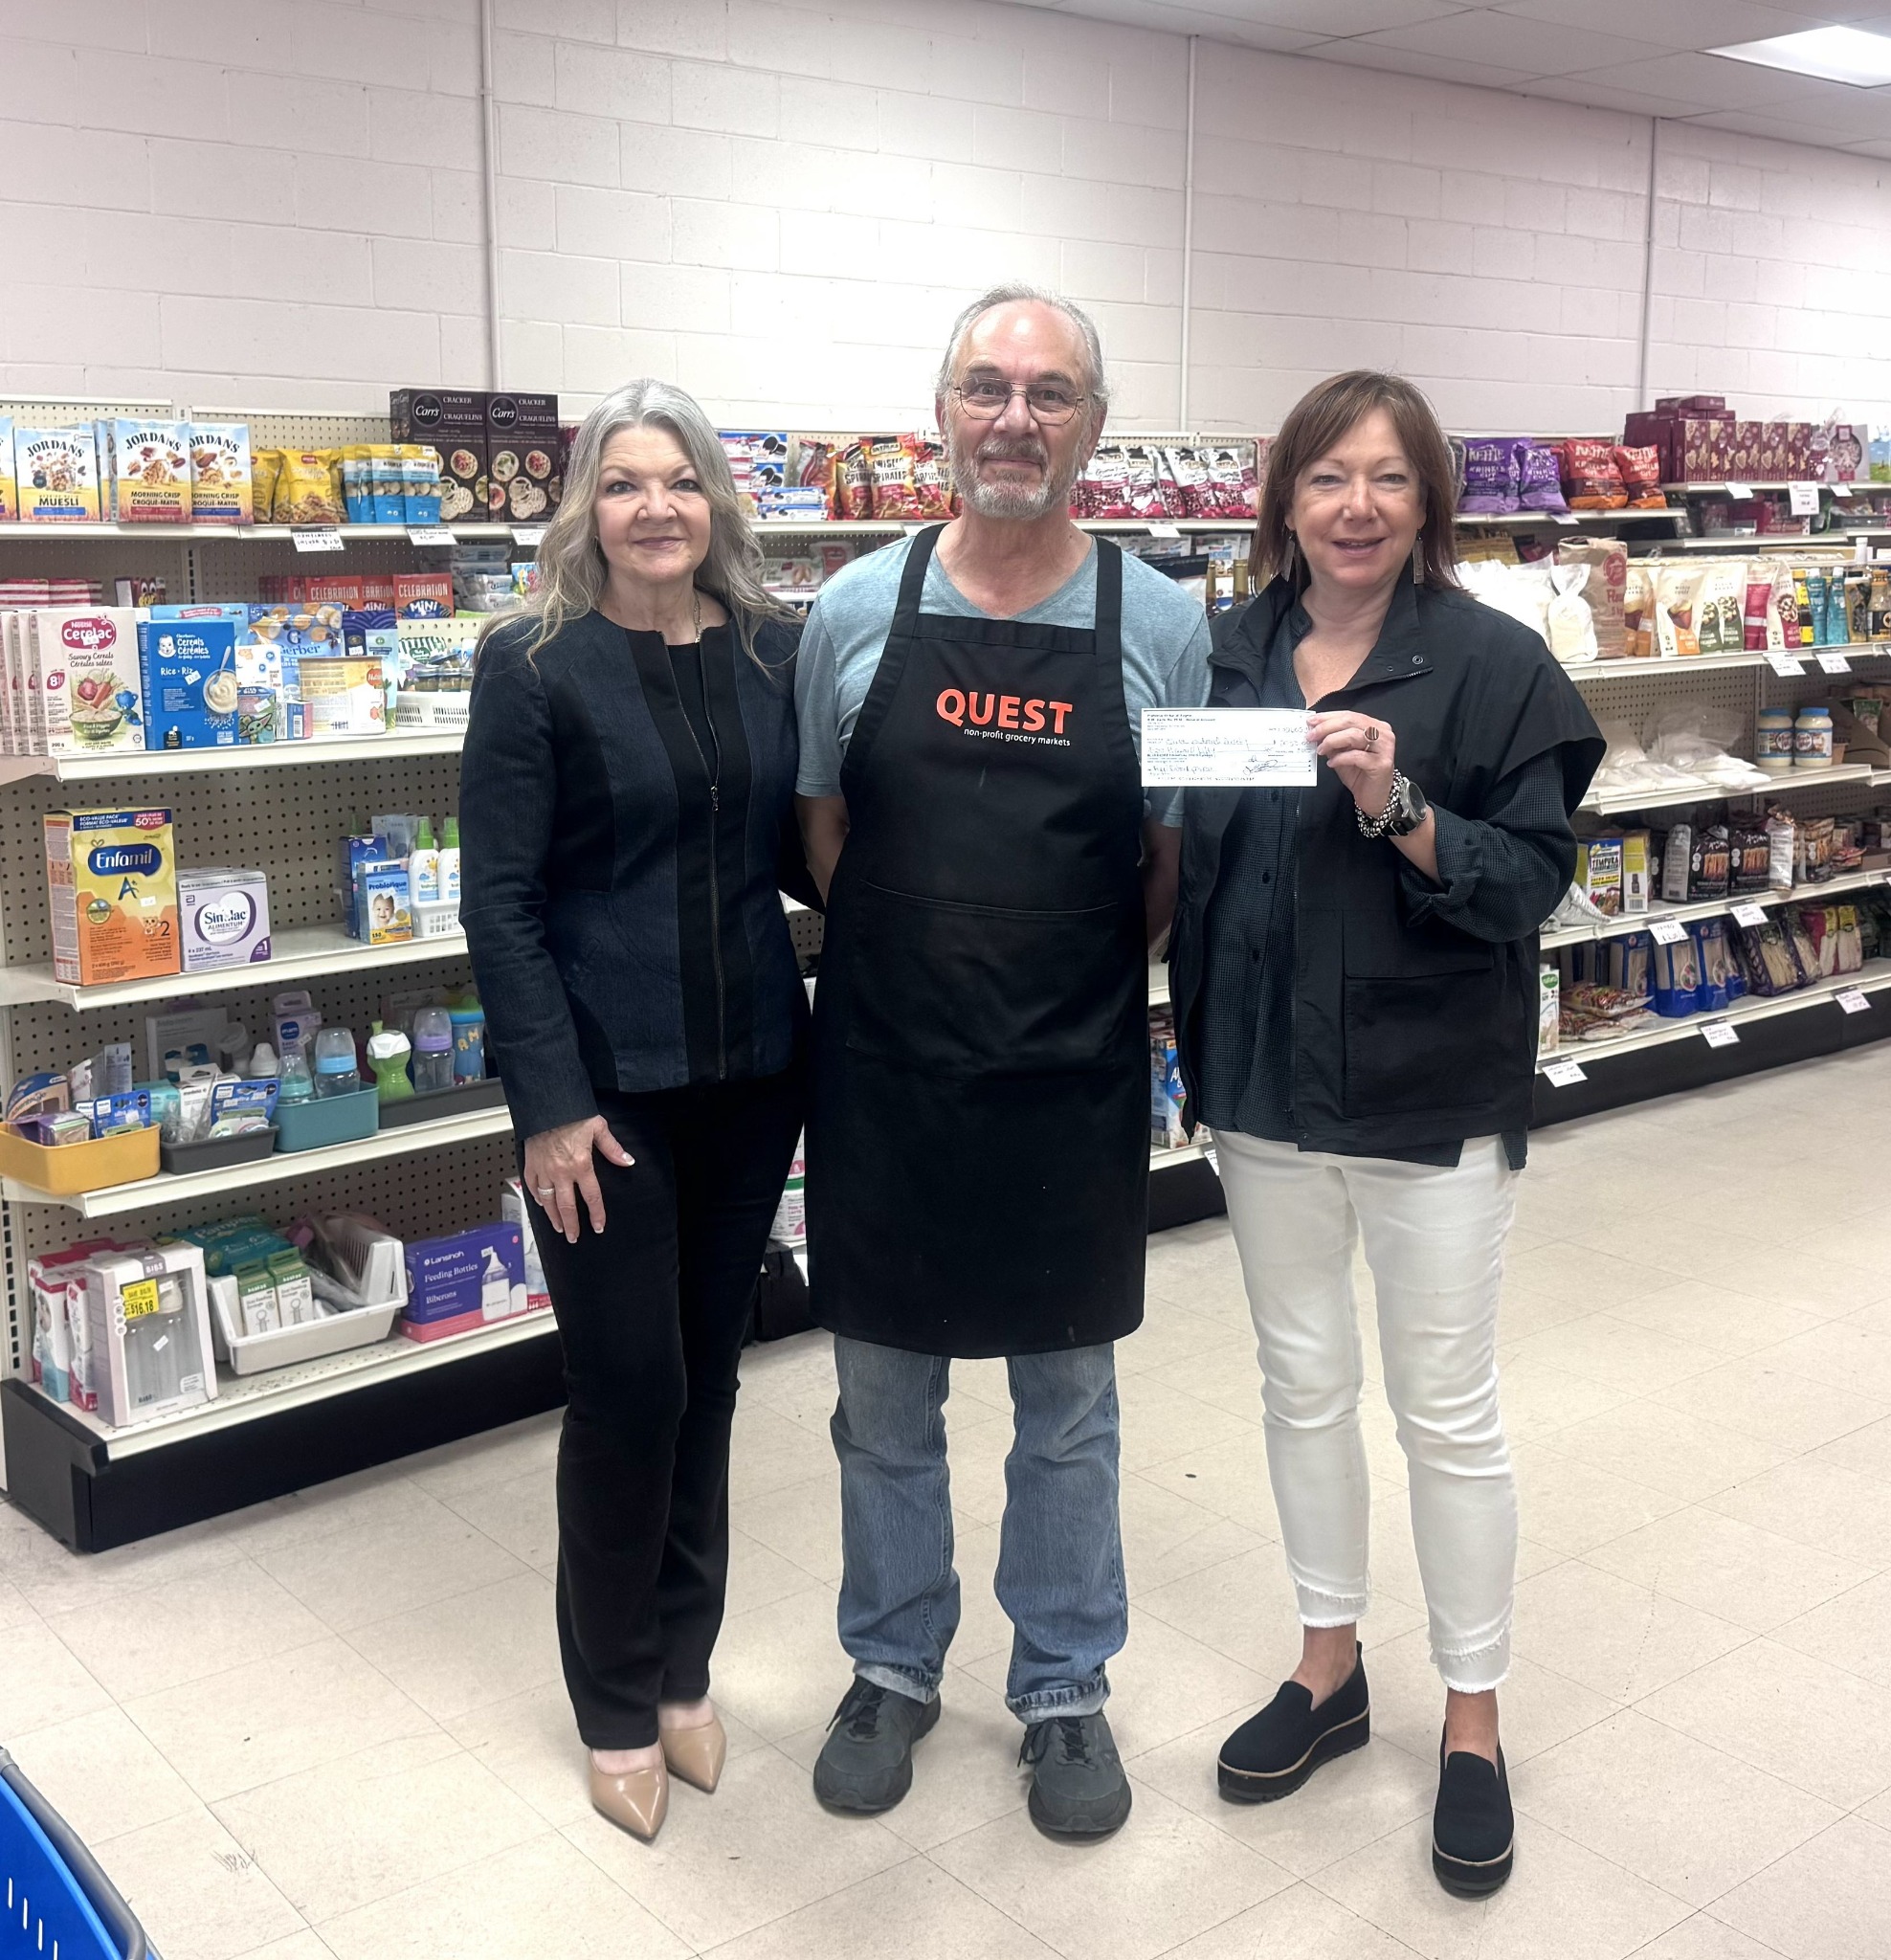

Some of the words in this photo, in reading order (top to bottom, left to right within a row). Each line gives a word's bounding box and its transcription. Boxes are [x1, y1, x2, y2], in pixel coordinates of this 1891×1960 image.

[442, 396, 473, 405] CRACKER
[415, 405, 440, 418] Carr's
[492, 408, 516, 419] Carr's
[27, 439, 85, 457] JORDANS
[125, 431, 182, 452] JORDANS
[189, 434, 240, 454] ORDANS
[39, 498, 79, 506] MUESLI
[311, 585, 359, 601] CELEBRATION
[398, 583, 448, 597] CELEBRATION
[177, 637, 205, 647] Cereals
[68, 653, 92, 661] Savoury
[160, 667, 177, 676] Rice
[49, 676, 58, 687] 8
[936, 688, 1073, 735] QUEST
[964, 728, 1004, 741] non-profit
[1005, 732, 1036, 745] grocery
[1037, 737, 1071, 747] markets
[96, 848, 152, 869] Enfamil
[160, 921, 170, 936] 2
[208, 922, 244, 930] ALIMENTUM
[431, 1250, 465, 1265] Lansinoh
[145, 1262, 164, 1274] BIBS
[424, 1269, 453, 1282] Feeding
[454, 1263, 478, 1274] Bottles
[426, 1290, 457, 1304] Biberons
